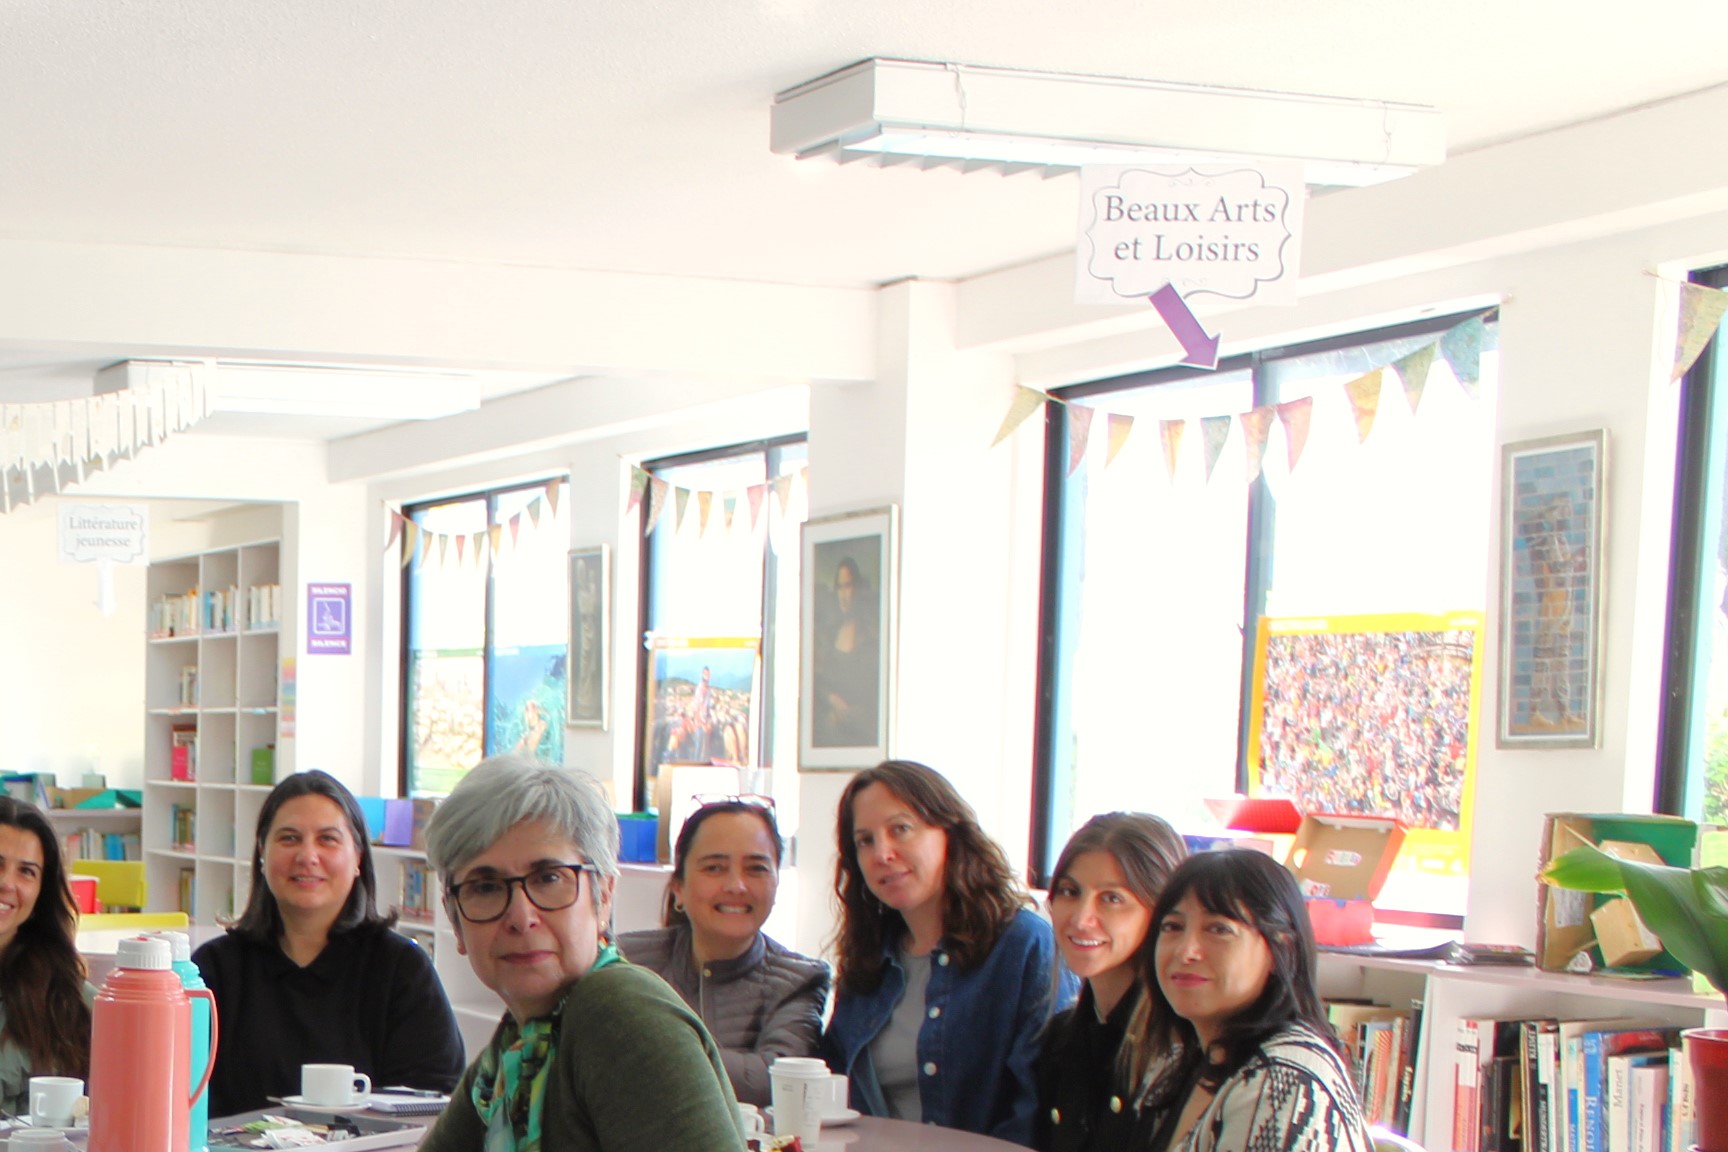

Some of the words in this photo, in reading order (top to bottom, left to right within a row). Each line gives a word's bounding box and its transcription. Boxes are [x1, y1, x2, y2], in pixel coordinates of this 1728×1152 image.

[1104, 194, 1199, 222] Beaux
[1208, 195, 1276, 222] Arts
[1114, 236, 1142, 261] et
[1153, 234, 1260, 262] Loisirs
[69, 516, 138, 530] Littérature
[75, 534, 131, 551] jeunesse
